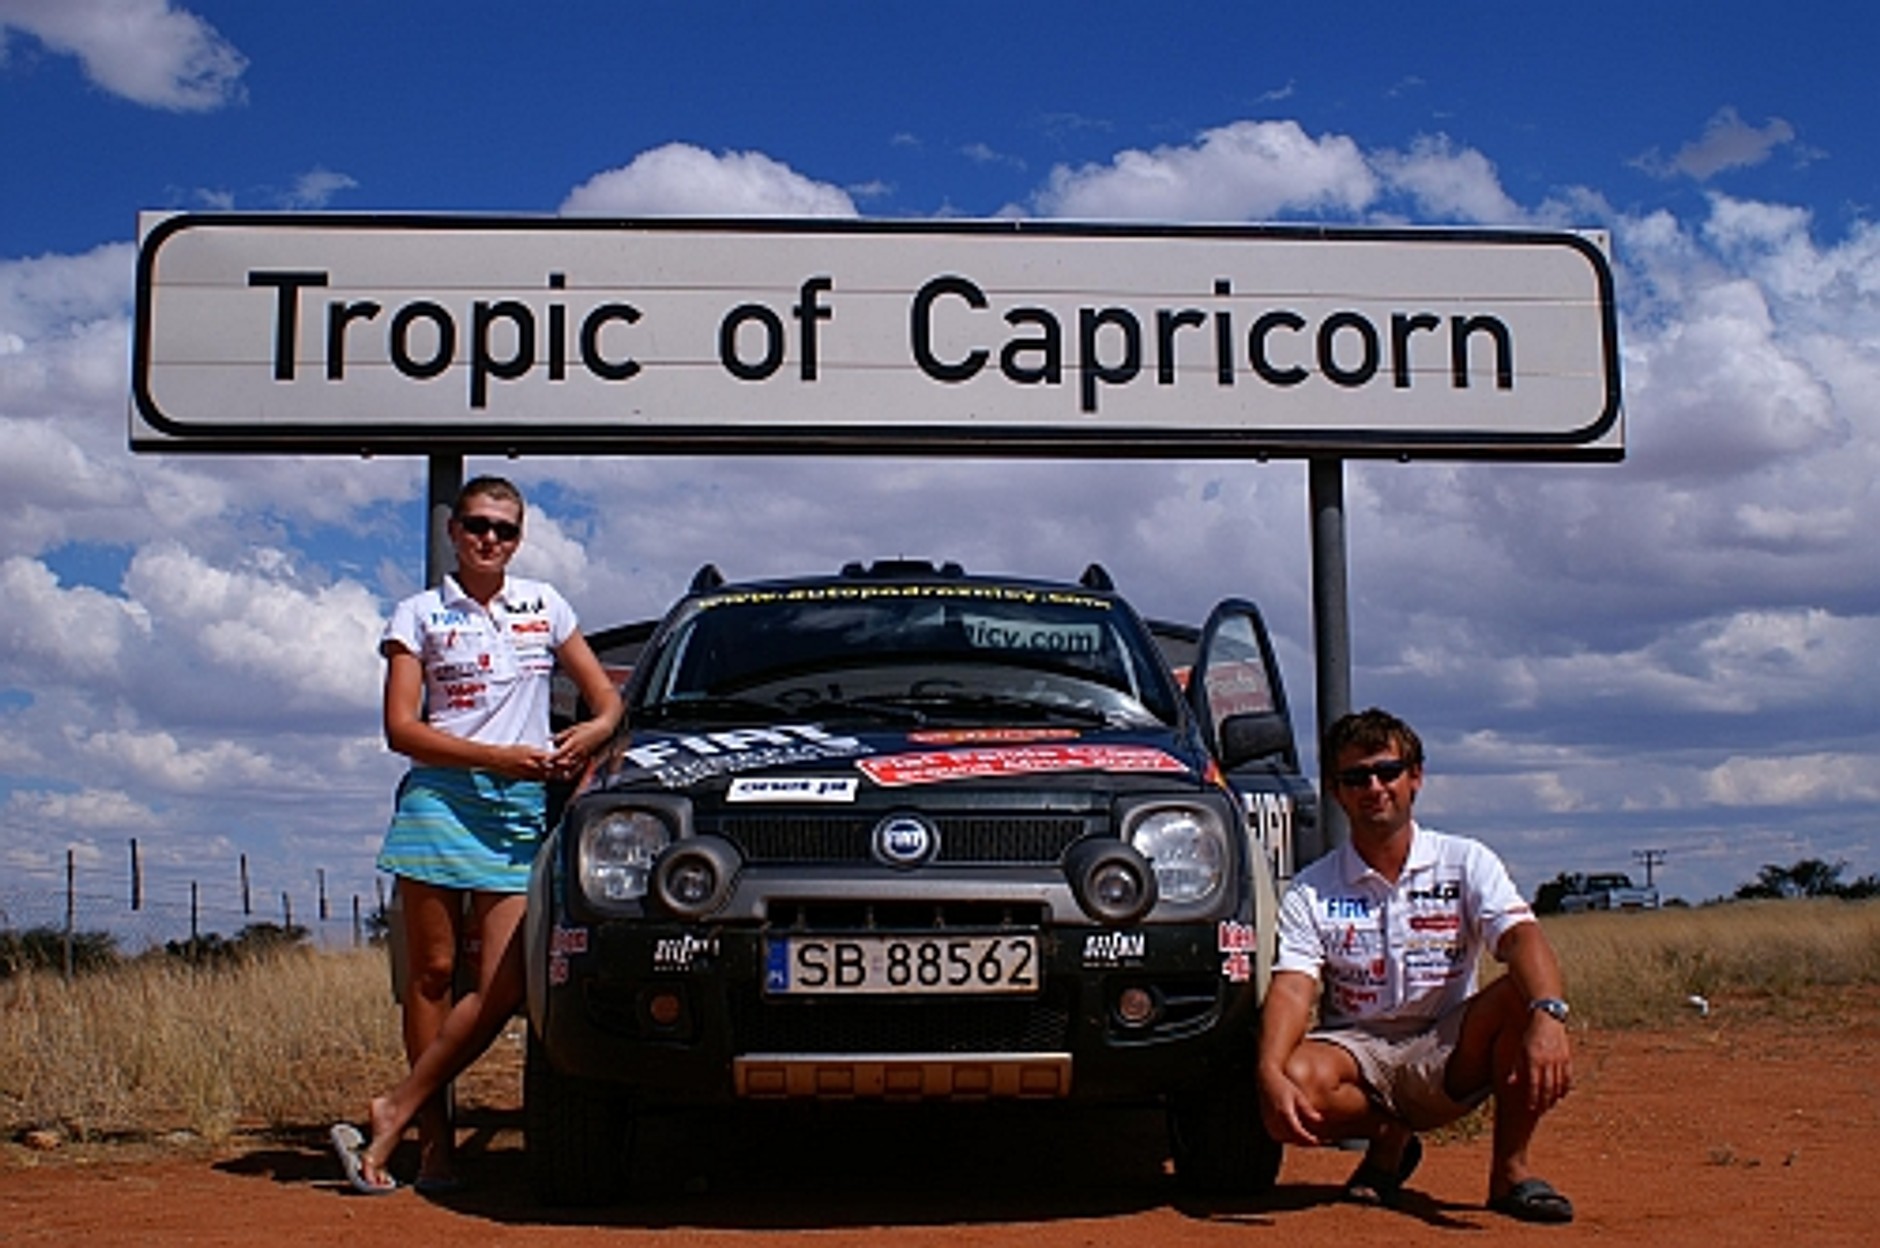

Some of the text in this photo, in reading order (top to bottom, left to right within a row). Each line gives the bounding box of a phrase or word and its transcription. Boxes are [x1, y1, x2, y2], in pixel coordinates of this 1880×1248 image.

[247, 270, 1513, 412] Tropic of Capricorn
[797, 940, 1033, 986] SB 88562
